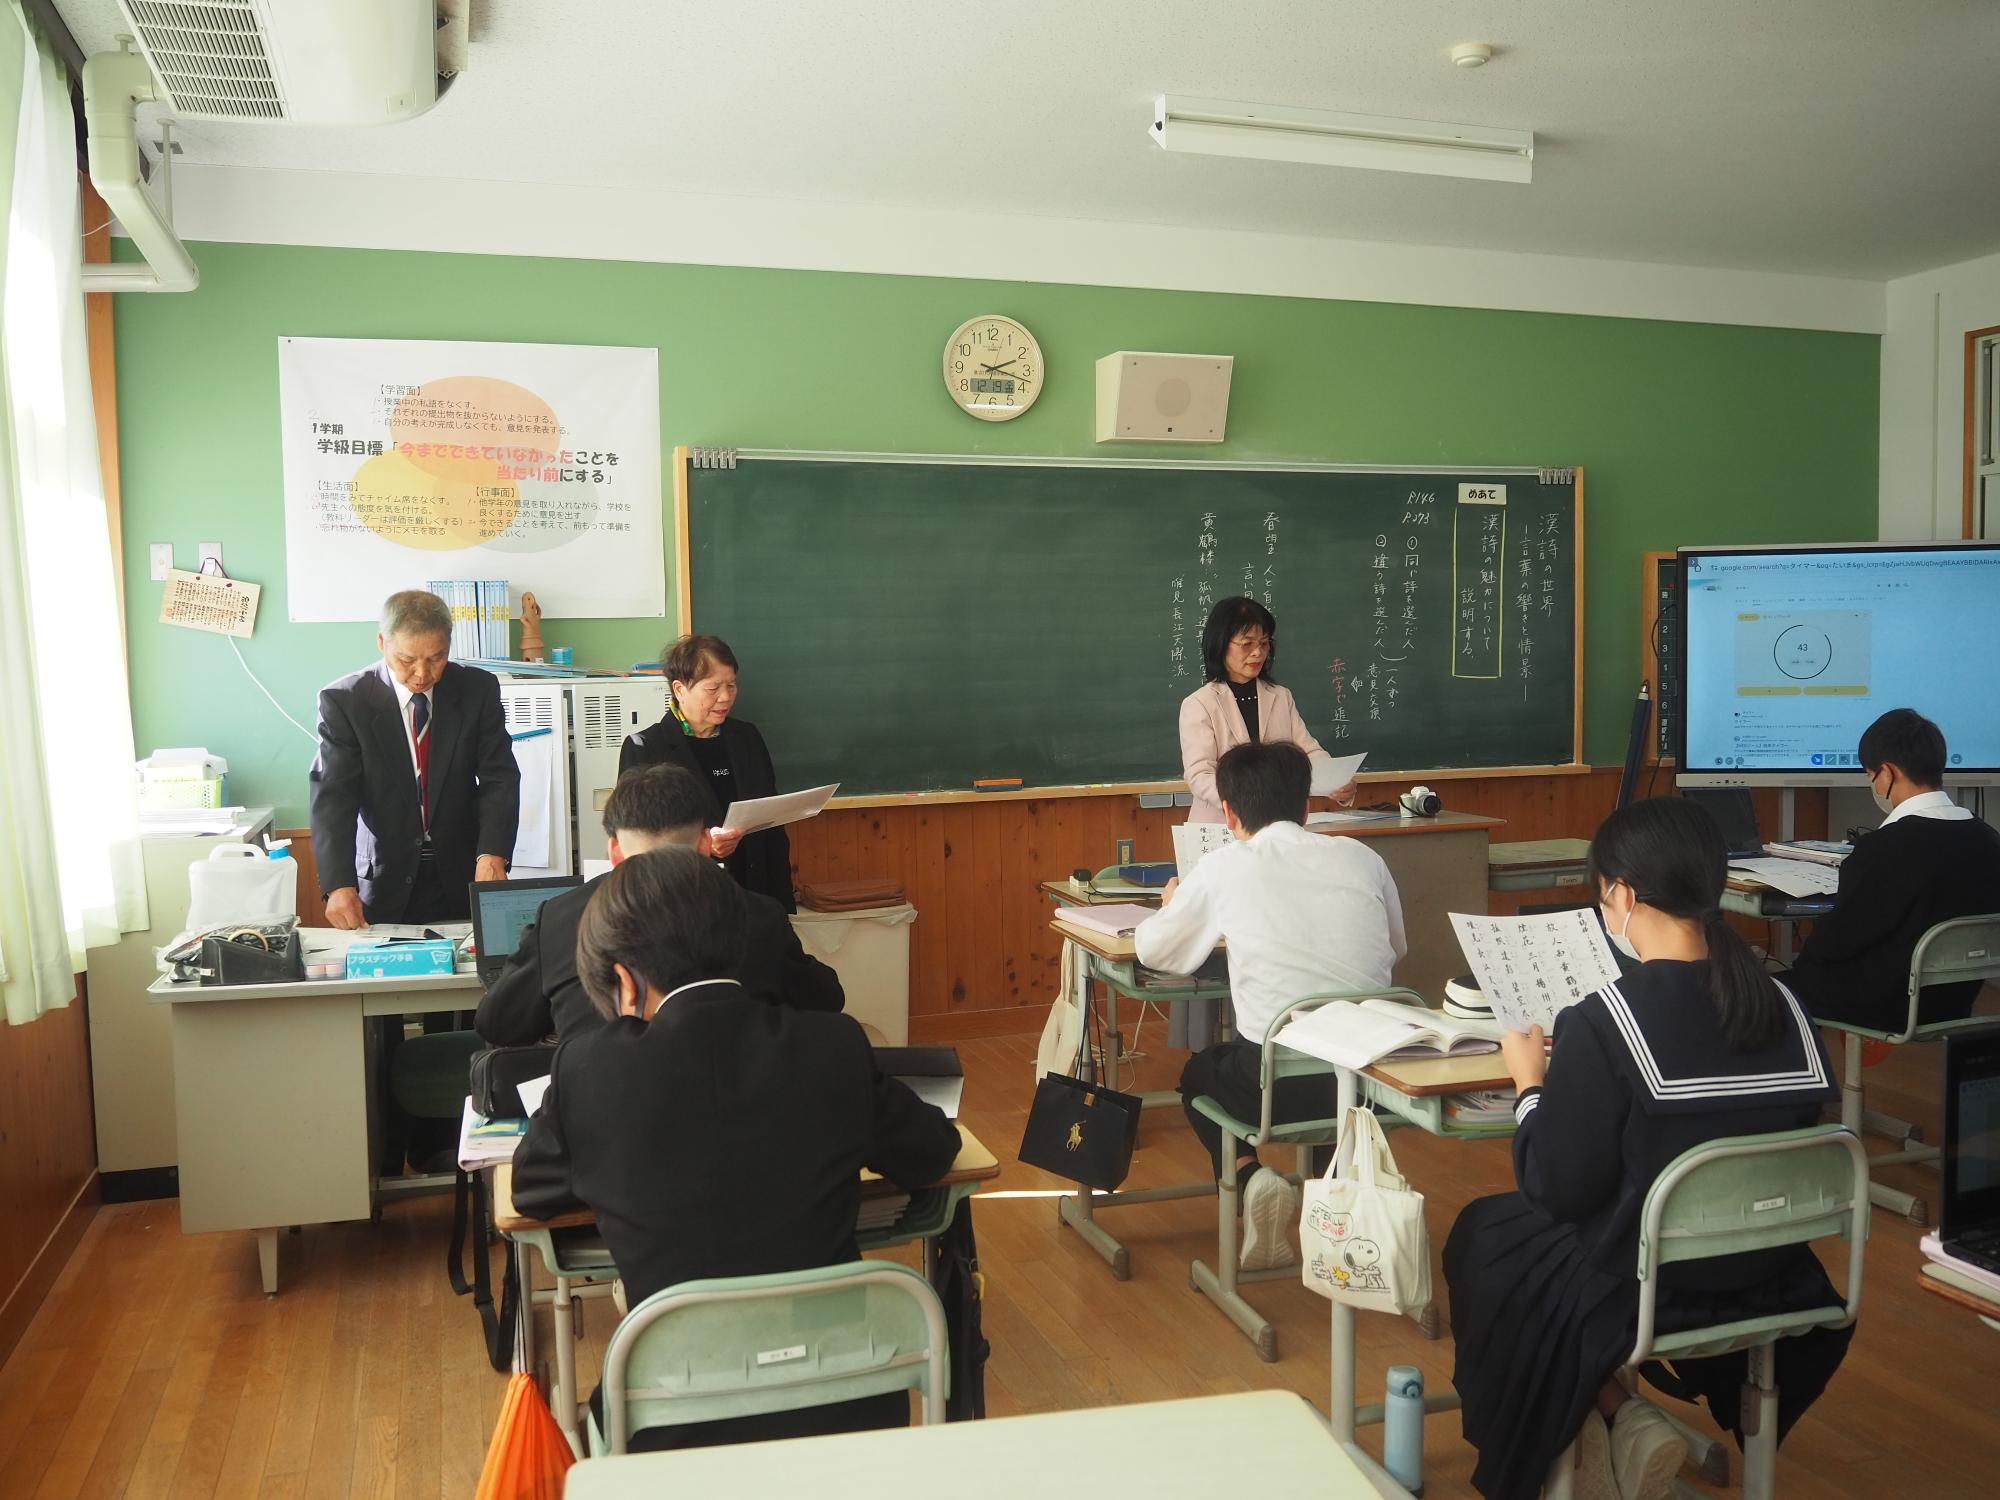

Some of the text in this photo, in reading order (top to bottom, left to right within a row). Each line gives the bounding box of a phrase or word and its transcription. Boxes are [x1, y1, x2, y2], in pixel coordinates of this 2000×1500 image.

[971, 332, 982, 345] 11
[987, 328, 999, 341] 12
[1007, 334, 1012, 346] 1
[958, 344, 971, 357] 10
[1017, 346, 1027, 360] 2
[954, 361, 964, 374] 9
[1022, 364, 1031, 377] 3
[380, 384, 422, 397] 【学習面】
[960, 379, 969, 392] 8
[976, 380, 987, 393] 12
[992, 380, 1002, 393] 19
[1017, 381, 1026, 394] 4
[972, 393, 981, 405] 7
[1006, 394, 1014, 406] 5
[312, 422, 344, 435] 1学期
[475, 487, 515, 498] 【行事面】
[1468, 488, 1497, 500] めあて
[1537, 513, 1560, 617] 漢詩の世界
[1480, 514, 1500, 651] 漢詩の魅力について
[1662, 626, 1669, 634] 2
[1662, 645, 1668, 653] 3
[1798, 642, 1809, 652] 43
[1662, 682, 1668, 691] 5
[1662, 702, 1668, 710] 6
